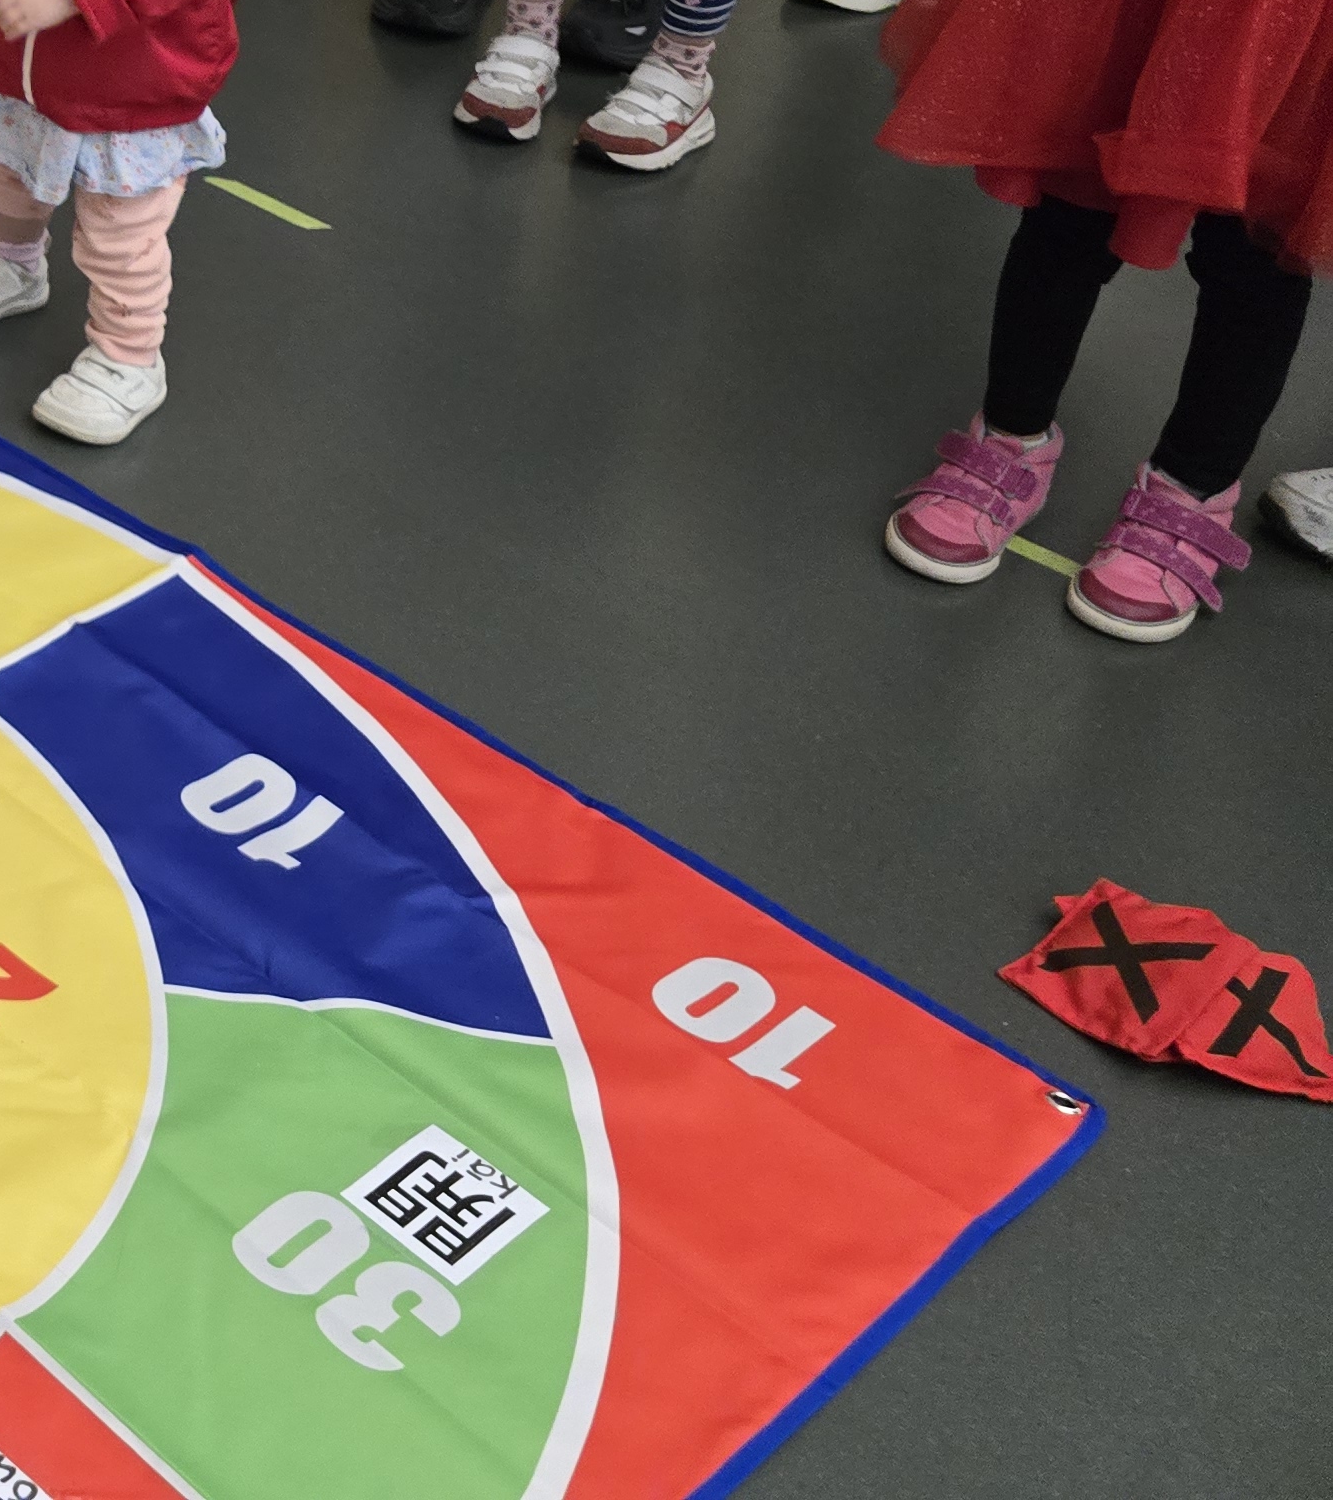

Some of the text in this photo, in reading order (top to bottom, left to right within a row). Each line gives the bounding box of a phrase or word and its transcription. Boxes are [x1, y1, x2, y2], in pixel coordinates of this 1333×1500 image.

[180, 752, 345, 870] 10
[651, 956, 837, 1090] 10
[363, 1150, 516, 1266] 開
[232, 1190, 461, 1371] 30
